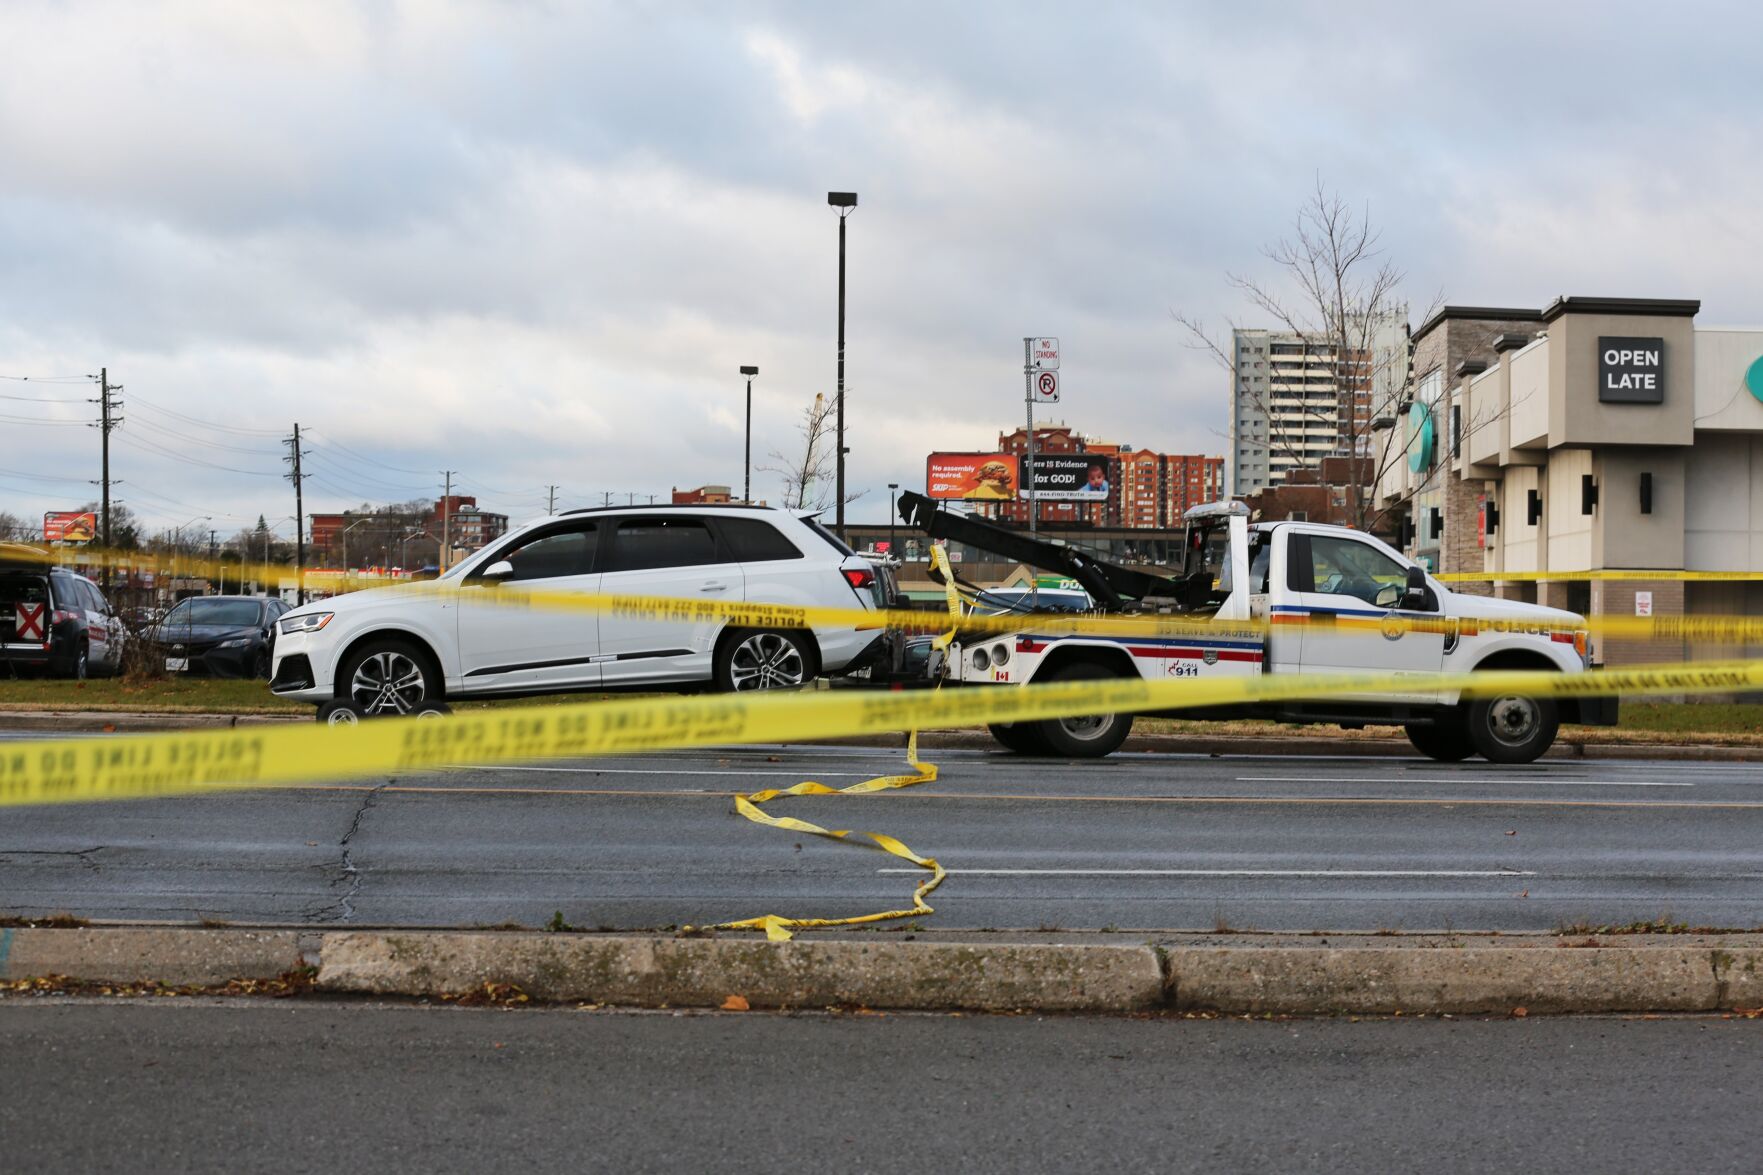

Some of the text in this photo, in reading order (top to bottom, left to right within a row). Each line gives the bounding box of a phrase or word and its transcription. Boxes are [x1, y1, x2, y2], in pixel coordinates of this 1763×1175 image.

[1042, 341, 1050, 349] NO
[1036, 351, 1057, 359] STANDING
[1604, 350, 1659, 366] OPEN
[1607, 373, 1656, 389] LATE
[943, 465, 975, 473] assembly
[1034, 473, 1076, 483] for GOD!
[932, 483, 949, 491] SKIP
[777, 608, 806, 618] Crime
[756, 615, 805, 627] POLICE
[1478, 619, 1551, 637] POLICE
[1220, 629, 1261, 639] PROTECT
